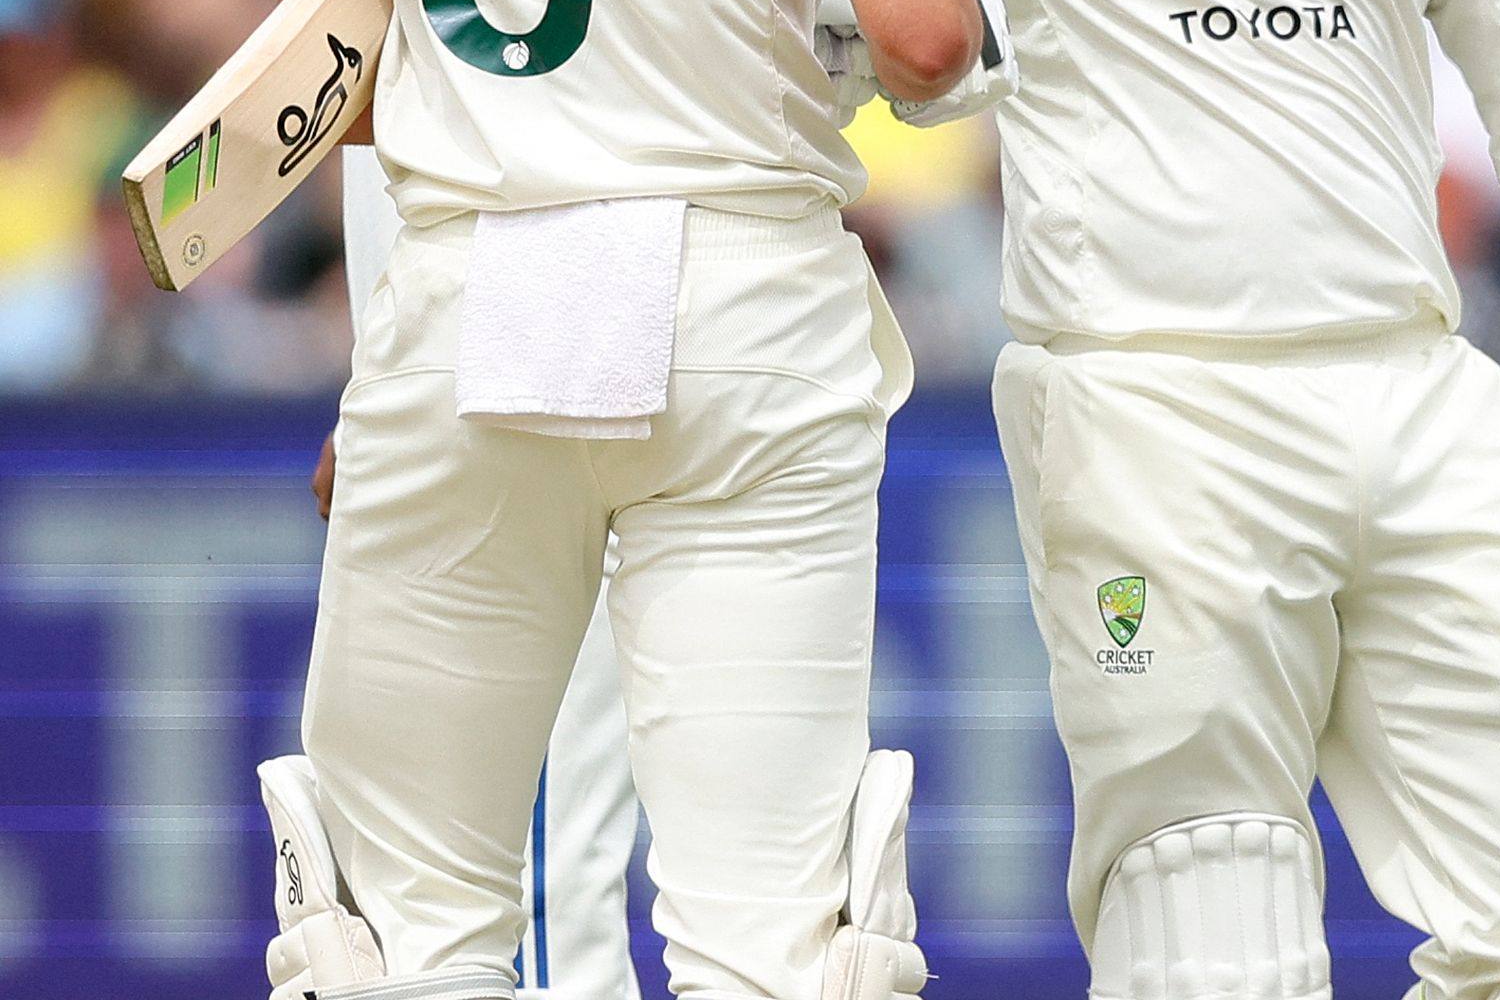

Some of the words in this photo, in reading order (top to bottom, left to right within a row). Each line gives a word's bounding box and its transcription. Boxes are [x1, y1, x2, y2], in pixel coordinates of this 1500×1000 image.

[1169, 5, 1356, 44] TOYOTA
[1096, 650, 1155, 665] CRICKET
[1104, 665, 1147, 674] AUSTRALIA
